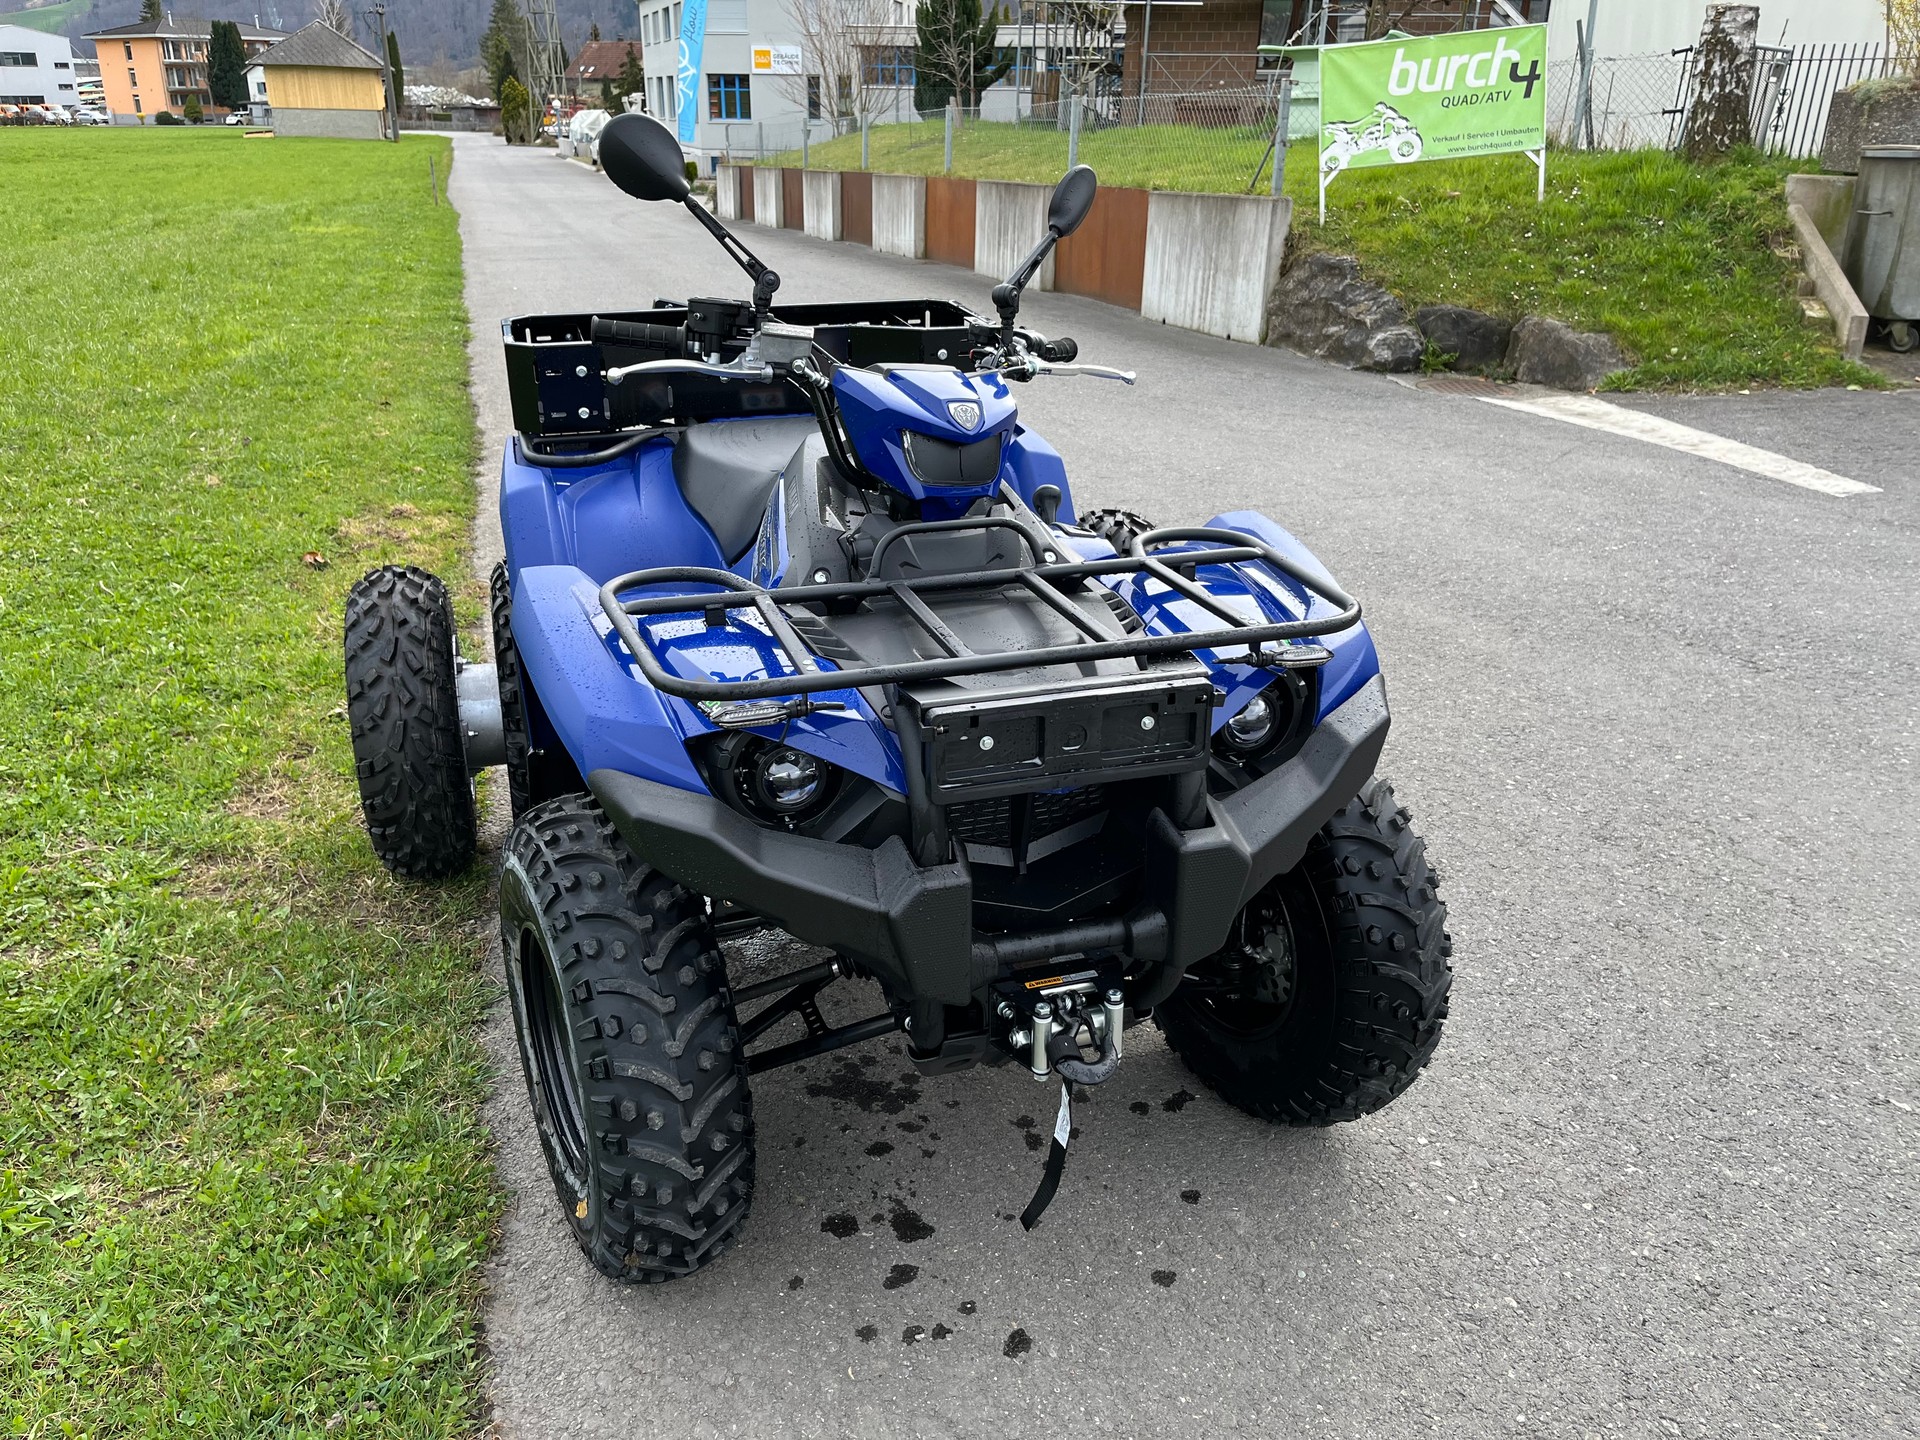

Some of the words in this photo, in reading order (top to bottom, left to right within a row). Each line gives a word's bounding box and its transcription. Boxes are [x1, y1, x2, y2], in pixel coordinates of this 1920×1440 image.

[683, 6, 698, 45] flow
[1441, 90, 1512, 109] QUAD/ATV
[1432, 134, 1460, 143] Verkauf
[1467, 132, 1495, 140] Service
[1500, 126, 1540, 136] Umbauten
[1447, 140, 1524, 153] www.burch4quad.ch
[1034, 977, 1061, 986] WARNING
